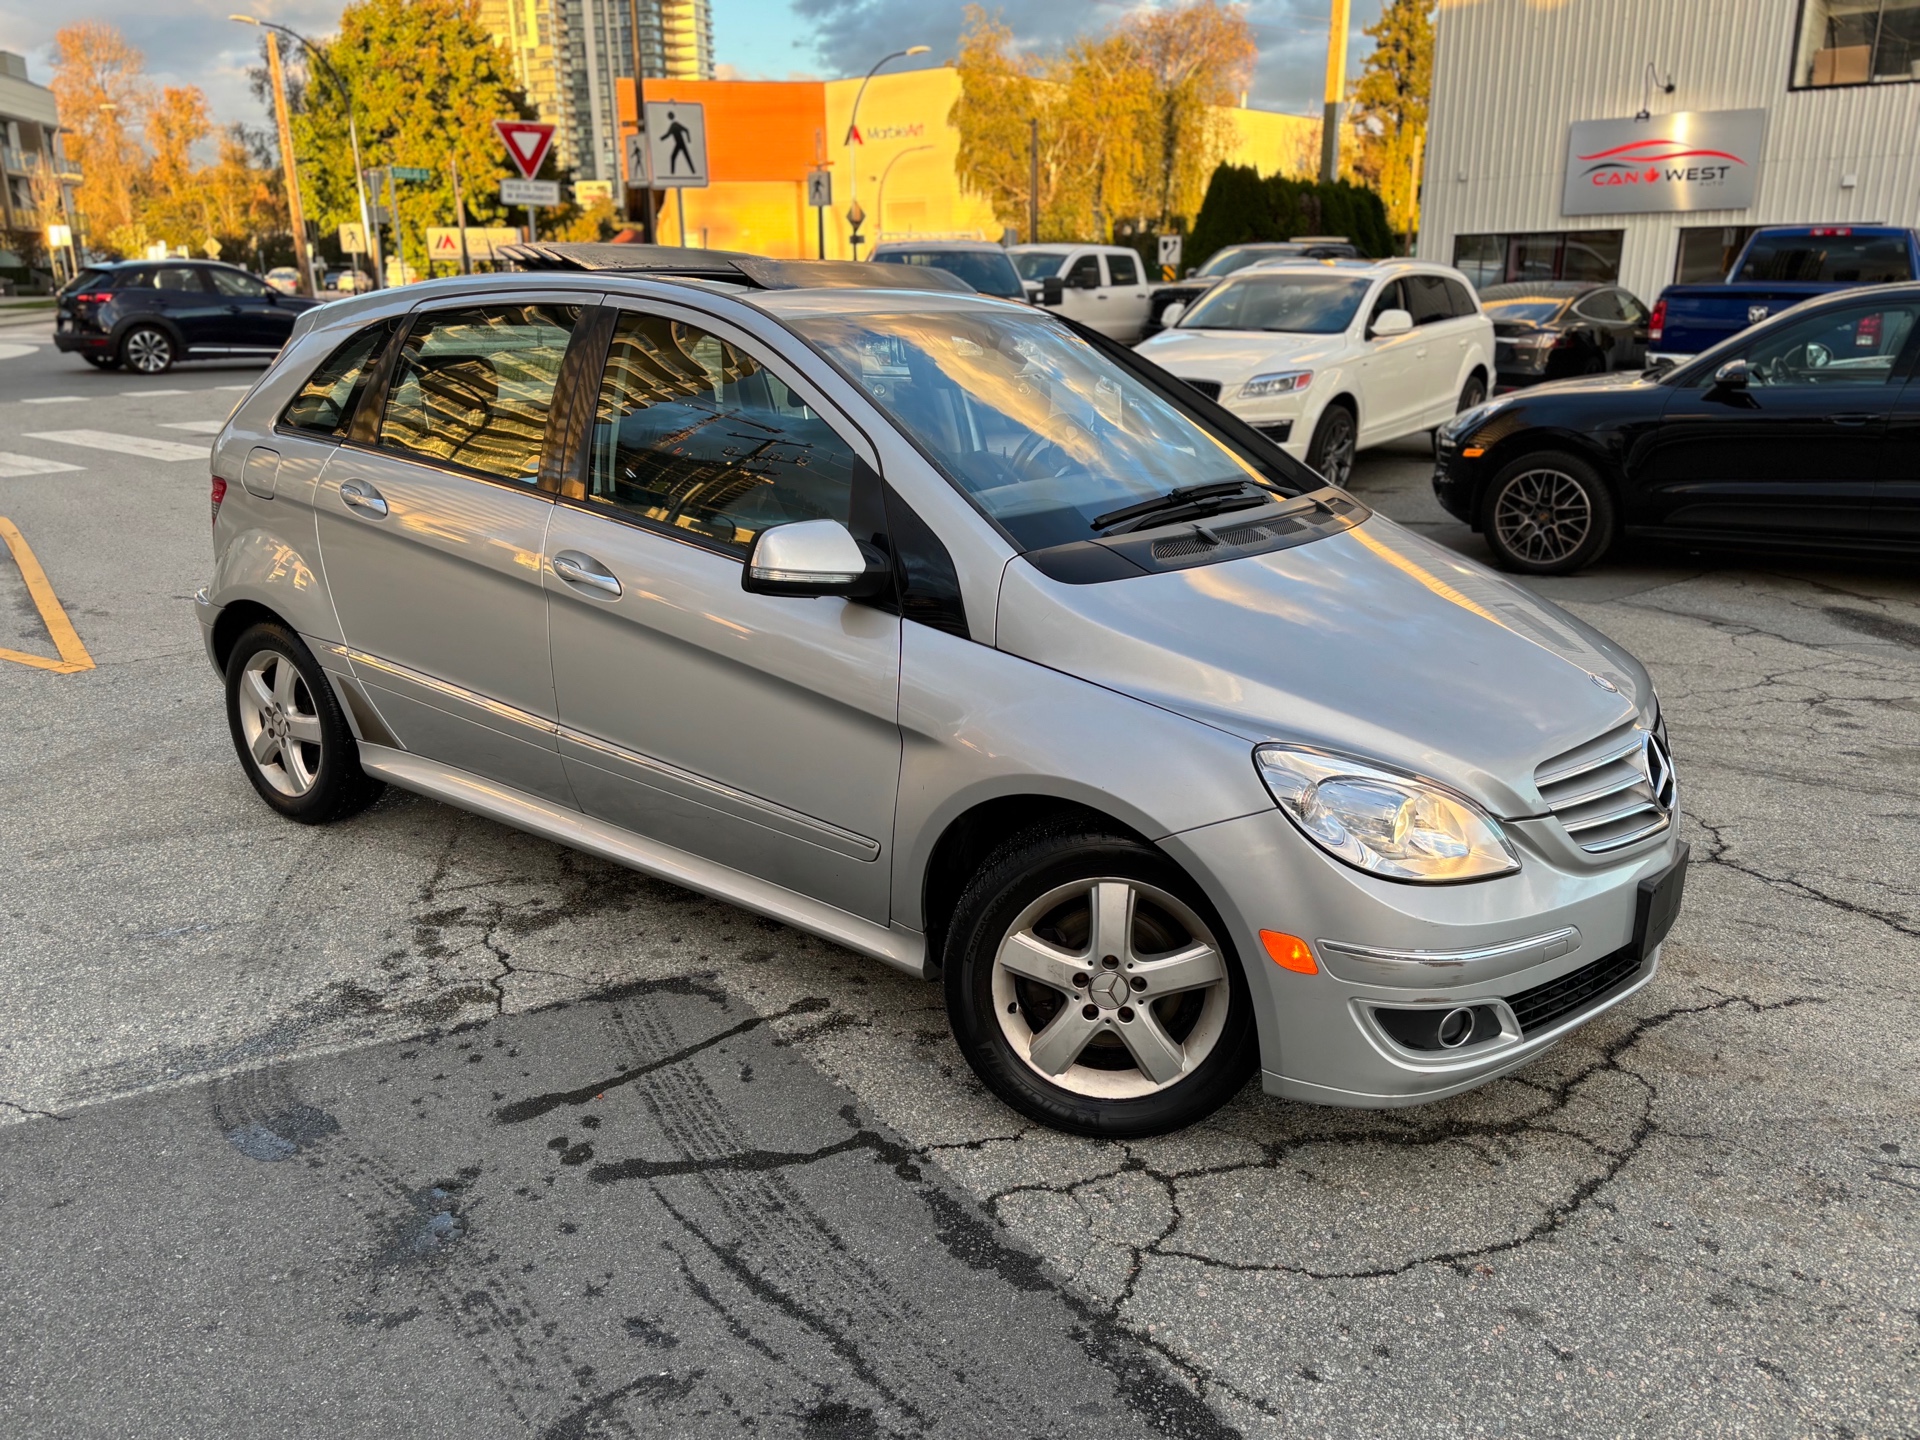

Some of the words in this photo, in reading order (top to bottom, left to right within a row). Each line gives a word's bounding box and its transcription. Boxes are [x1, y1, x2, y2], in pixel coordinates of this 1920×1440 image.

[1592, 171, 1640, 186] CAN
[1665, 166, 1731, 181] WEST
[977, 1047, 1074, 1120] MICHELIN
